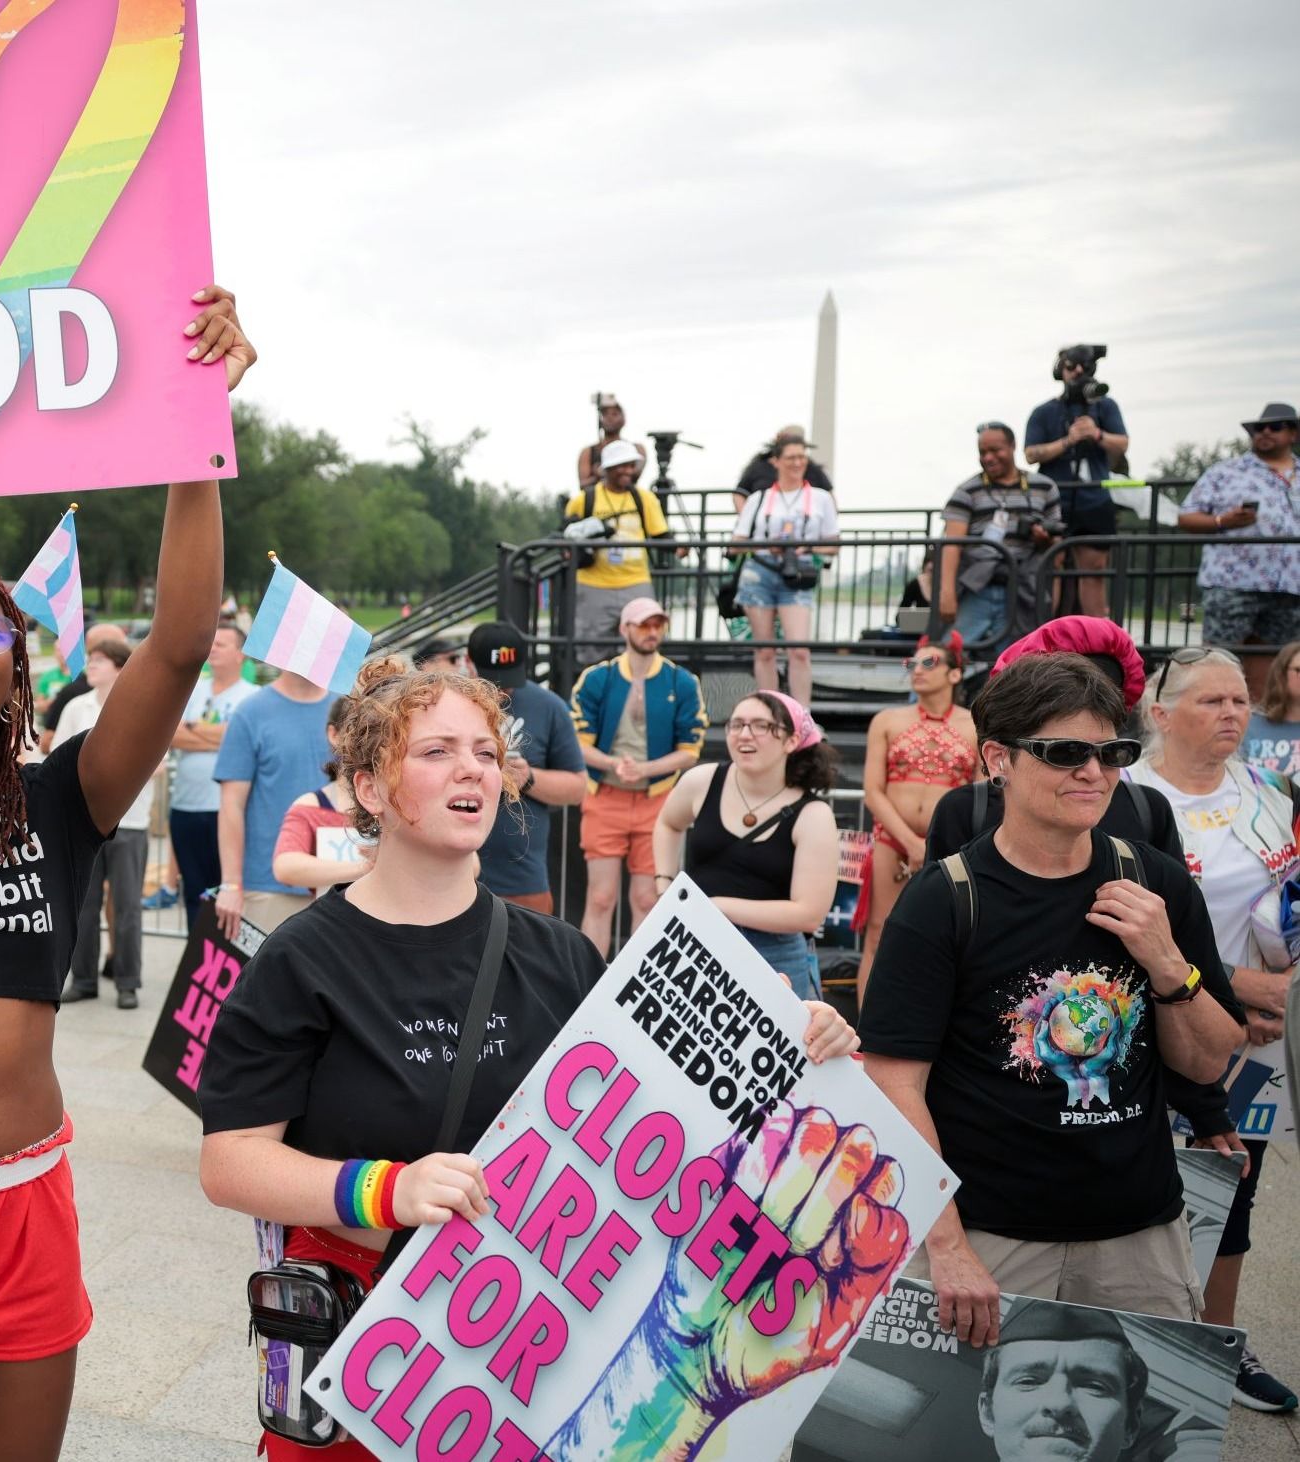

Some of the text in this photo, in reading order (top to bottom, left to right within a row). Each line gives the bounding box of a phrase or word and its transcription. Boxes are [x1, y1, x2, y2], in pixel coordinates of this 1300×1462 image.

[398, 1018, 459, 1037] WOMEN
[404, 1047, 433, 1064] OWE
[442, 1045, 457, 1062] YO
[615, 976, 767, 1145] FREEDOM
[637, 960, 778, 1118] WASHINGTON FOR
[646, 937, 797, 1101] MARCH ON
[663, 915, 807, 1079] INTERNATIONAL
[482, 1126, 642, 1313] ARE
[544, 1041, 819, 1336] CLOSETS
[400, 1217, 569, 1408] FOR
